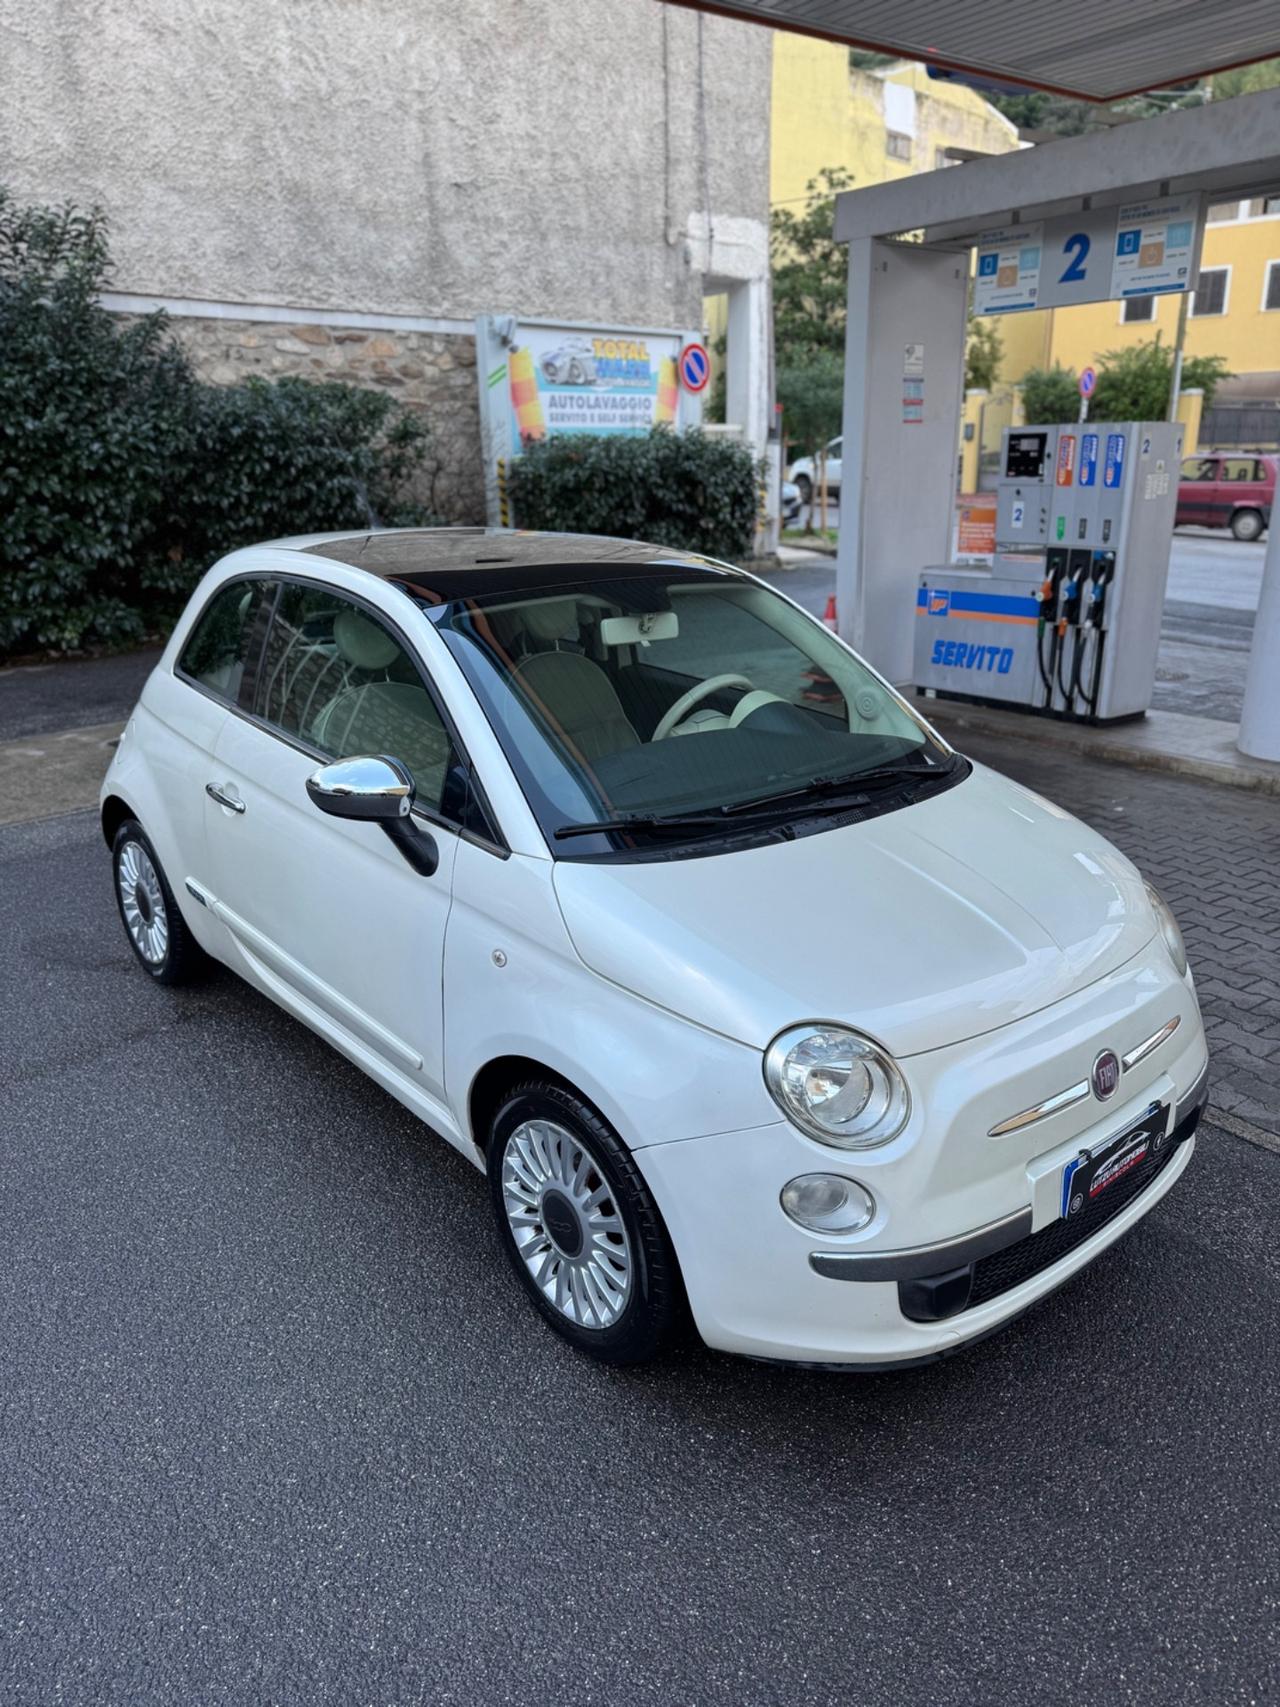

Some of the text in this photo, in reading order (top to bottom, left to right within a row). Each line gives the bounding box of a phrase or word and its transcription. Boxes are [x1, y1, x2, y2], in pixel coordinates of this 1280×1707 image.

[1058, 233, 1090, 283] 2
[592, 338, 650, 360] TOTAL
[549, 395, 652, 410] AUTOLAVAGGIO
[550, 412, 588, 423] SERVITO
[1143, 438, 1150, 454] 2
[1014, 508, 1023, 521] 2
[931, 639, 1014, 674] SERVITO
[1098, 1062, 1116, 1090] FIAT
